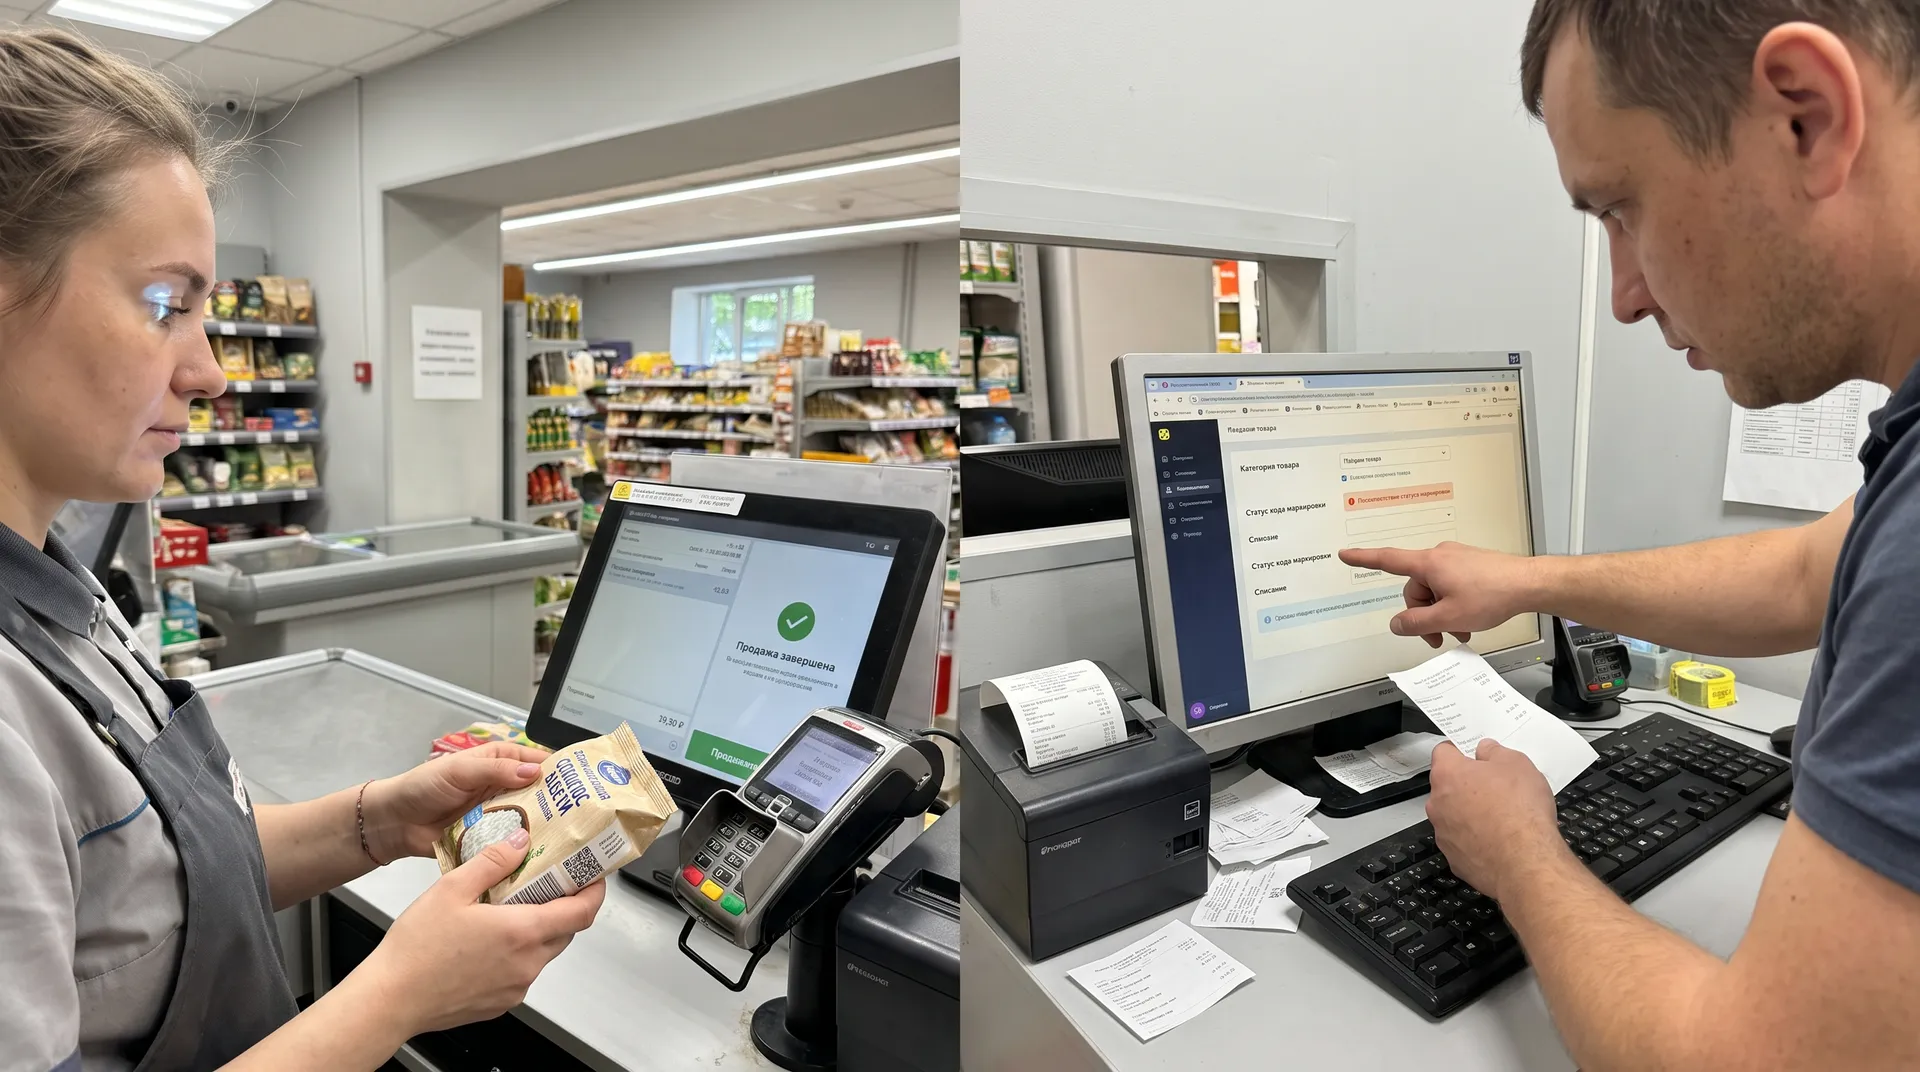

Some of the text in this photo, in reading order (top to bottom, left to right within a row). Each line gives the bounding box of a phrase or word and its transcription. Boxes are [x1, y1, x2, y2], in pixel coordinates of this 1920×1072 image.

[1276, 461, 1300, 470] товара
[1245, 507, 1269, 517] Статус
[1251, 552, 1332, 571] Статус кода маркировки
[1254, 585, 1287, 596] Списание
[735, 640, 779, 660] Продажа
[780, 651, 836, 673] завершена
